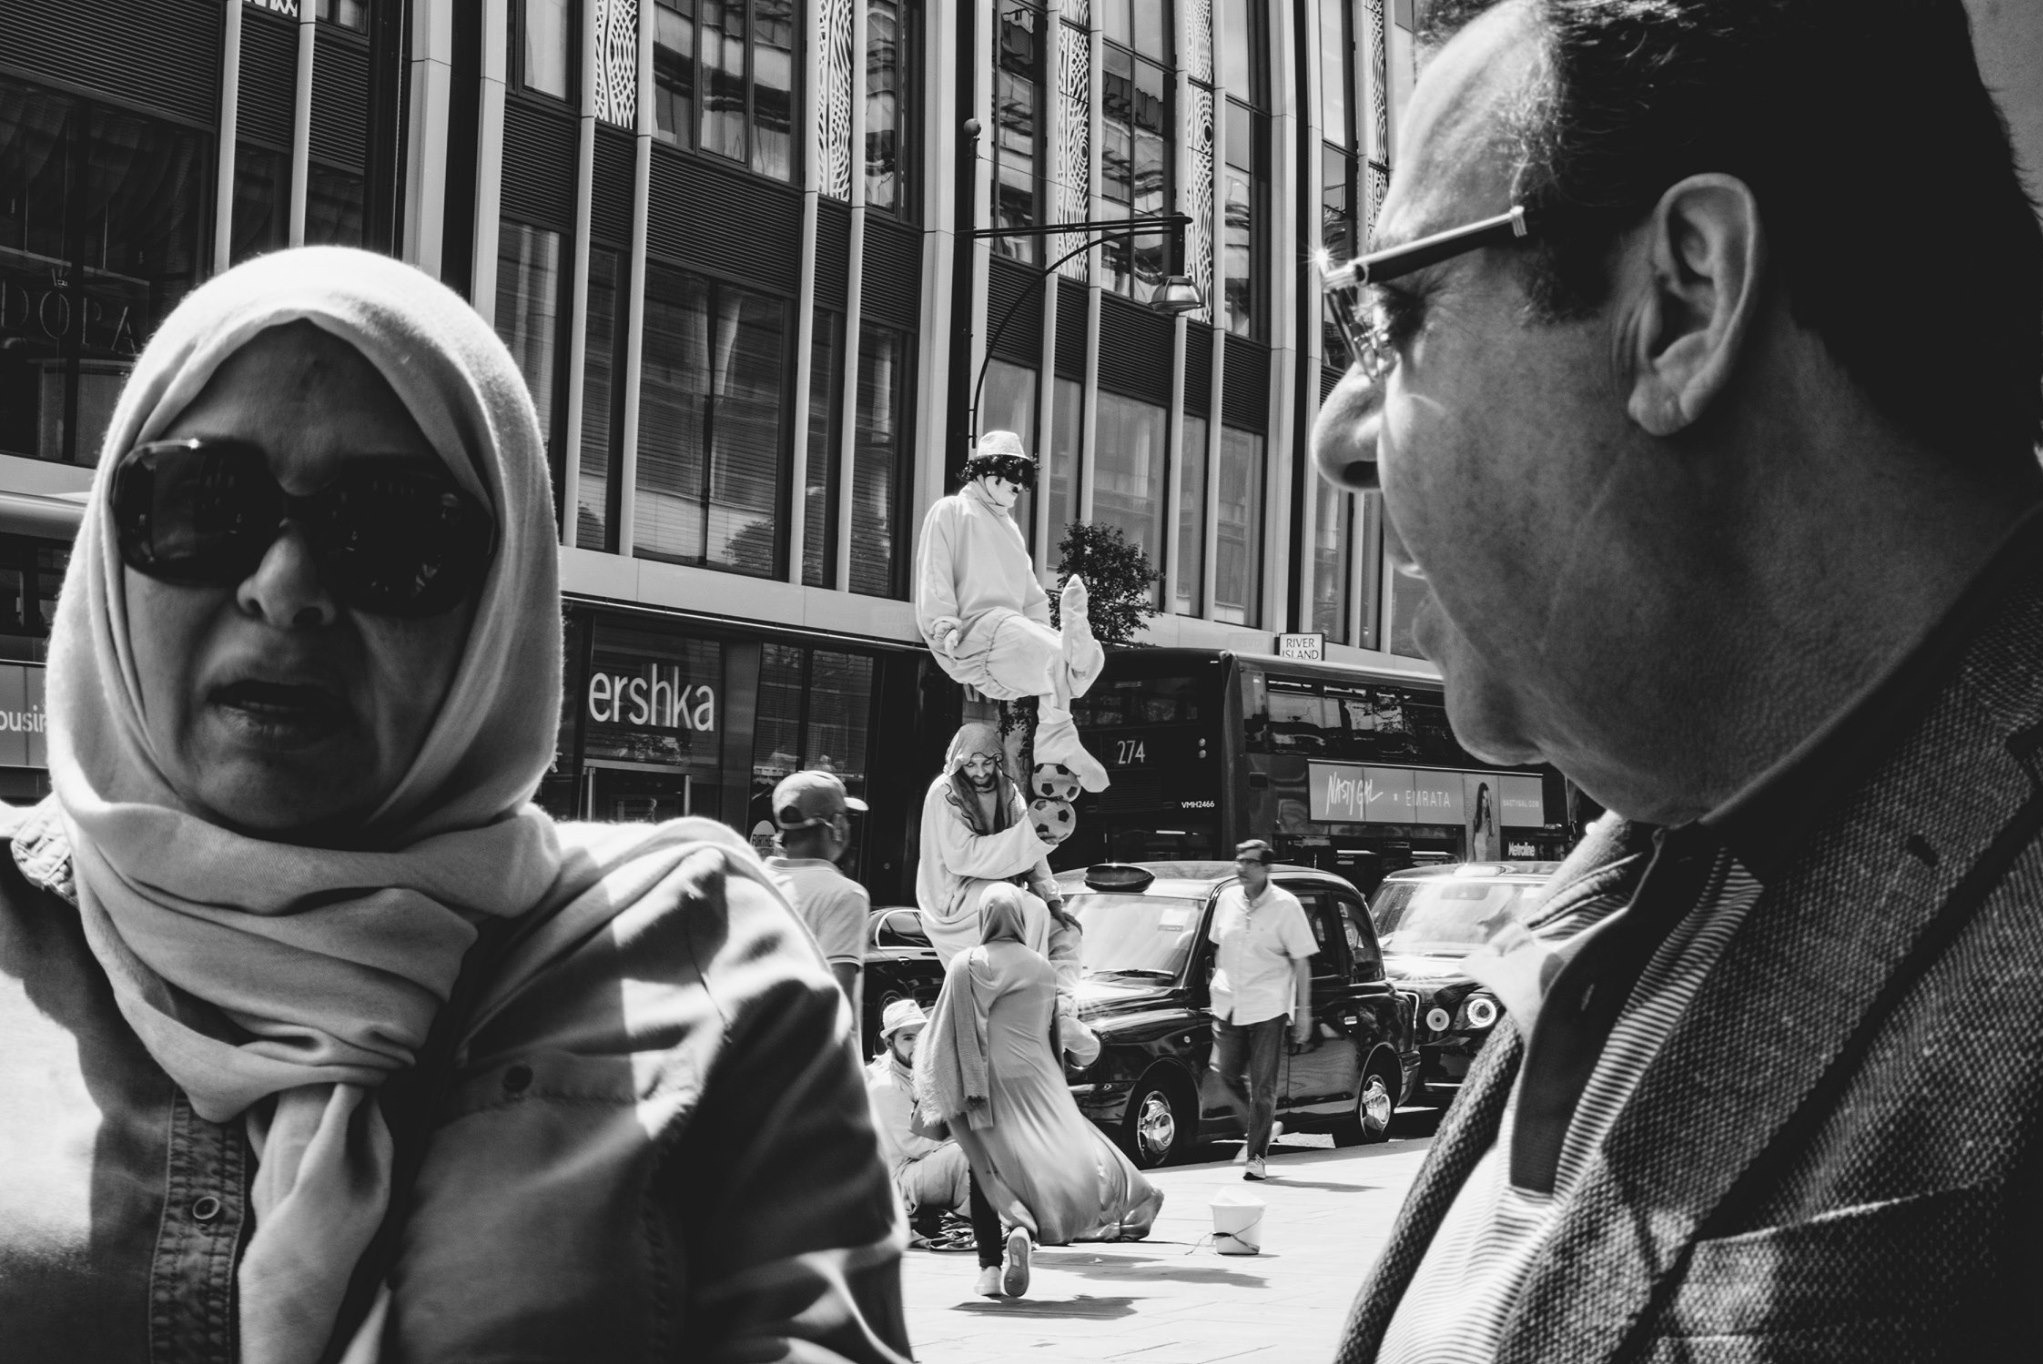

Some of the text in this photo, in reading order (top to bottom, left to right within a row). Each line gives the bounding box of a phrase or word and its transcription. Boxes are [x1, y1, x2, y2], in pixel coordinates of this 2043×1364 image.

[1286, 637, 1315, 649] RIVER
[1282, 649, 1319, 661] ISLAND
[588, 663, 715, 732] ershka
[1117, 740, 1146, 764] 274
[1181, 800, 1215, 809] VMH2466
[1405, 789, 1451, 808] EMRATA
